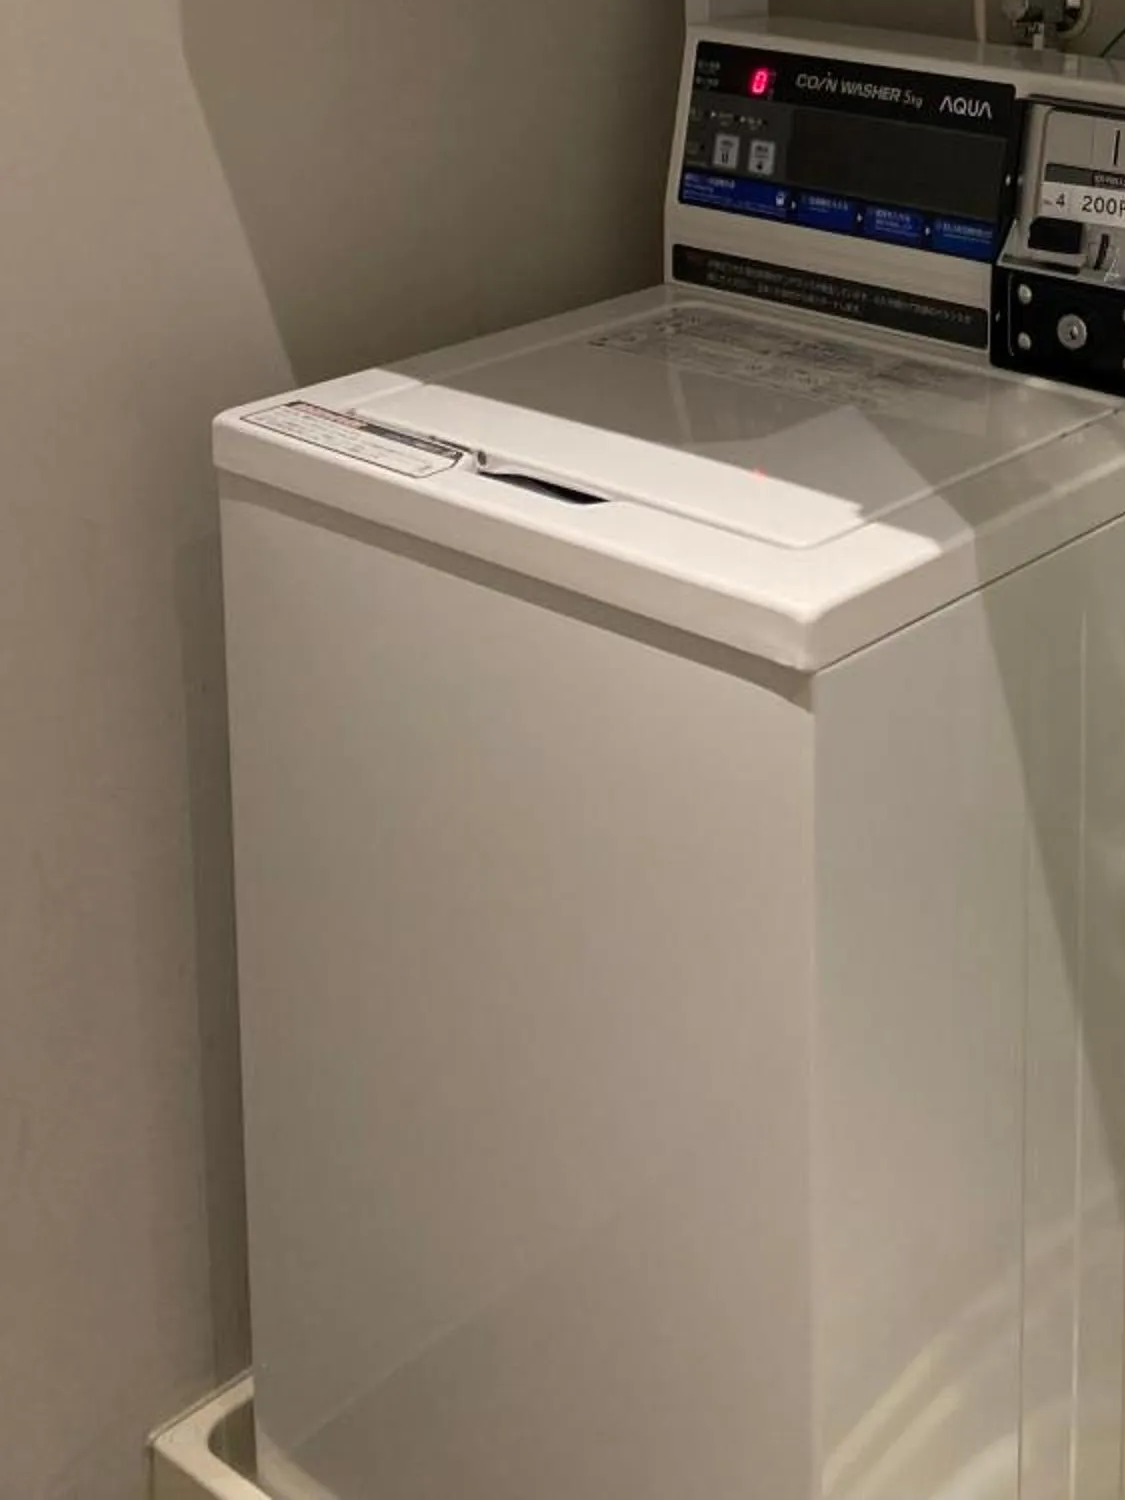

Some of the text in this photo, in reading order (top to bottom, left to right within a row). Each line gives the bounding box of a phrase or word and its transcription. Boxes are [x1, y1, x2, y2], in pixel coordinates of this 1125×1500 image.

[752, 68, 769, 94] 0
[841, 80, 902, 102] WASHER
[939, 96, 993, 120] AQUA
